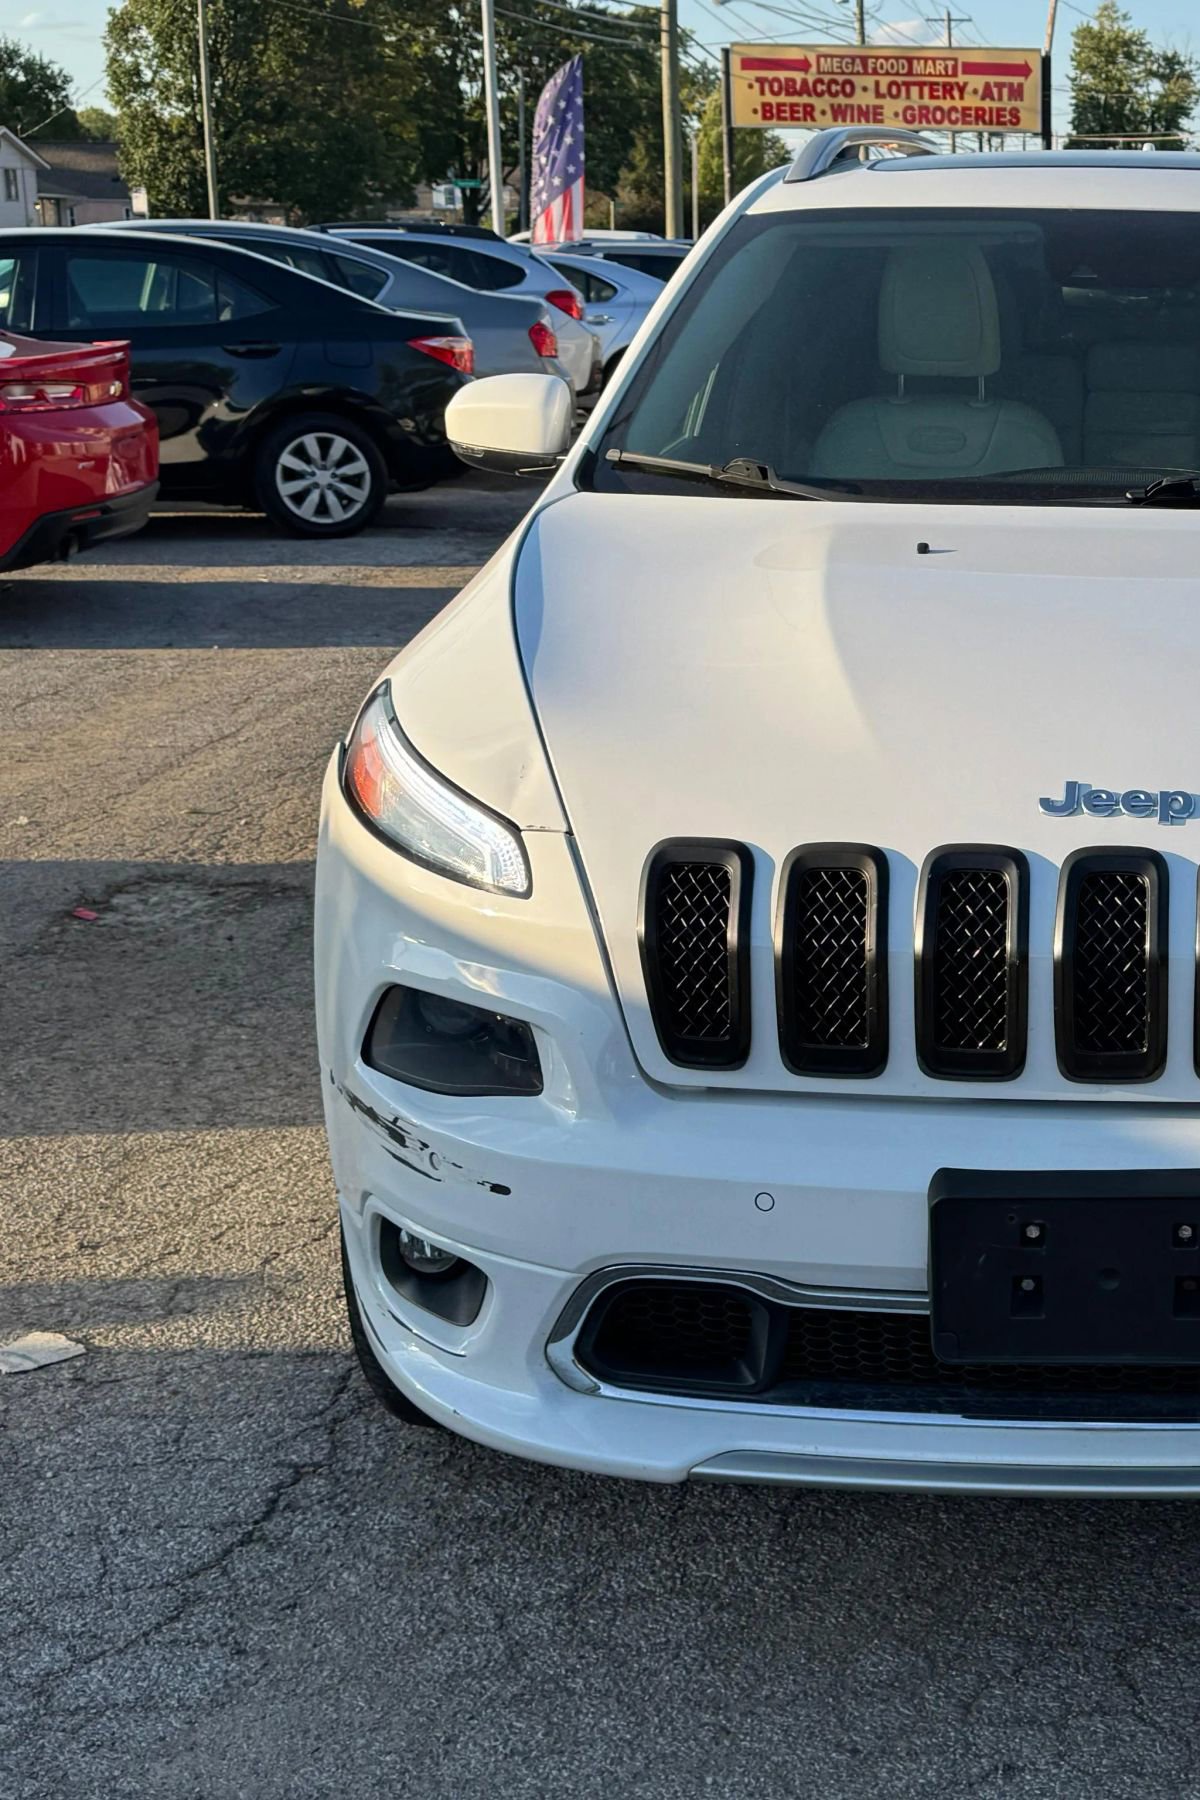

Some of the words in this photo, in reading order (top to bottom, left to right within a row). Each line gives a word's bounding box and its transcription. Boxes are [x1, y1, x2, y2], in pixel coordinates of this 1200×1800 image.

[819, 56, 864, 74] MEGA
[867, 58, 909, 75] FOOD
[912, 60, 956, 77] MART
[754, 77, 856, 99] TOBACCO
[874, 80, 969, 101] LOTTERY
[980, 82, 1025, 102] ATM
[760, 102, 817, 123] BEER
[830, 103, 885, 125] WINE
[902, 105, 1022, 127] GROCERIES
[1039, 780, 1195, 826] Jeep
